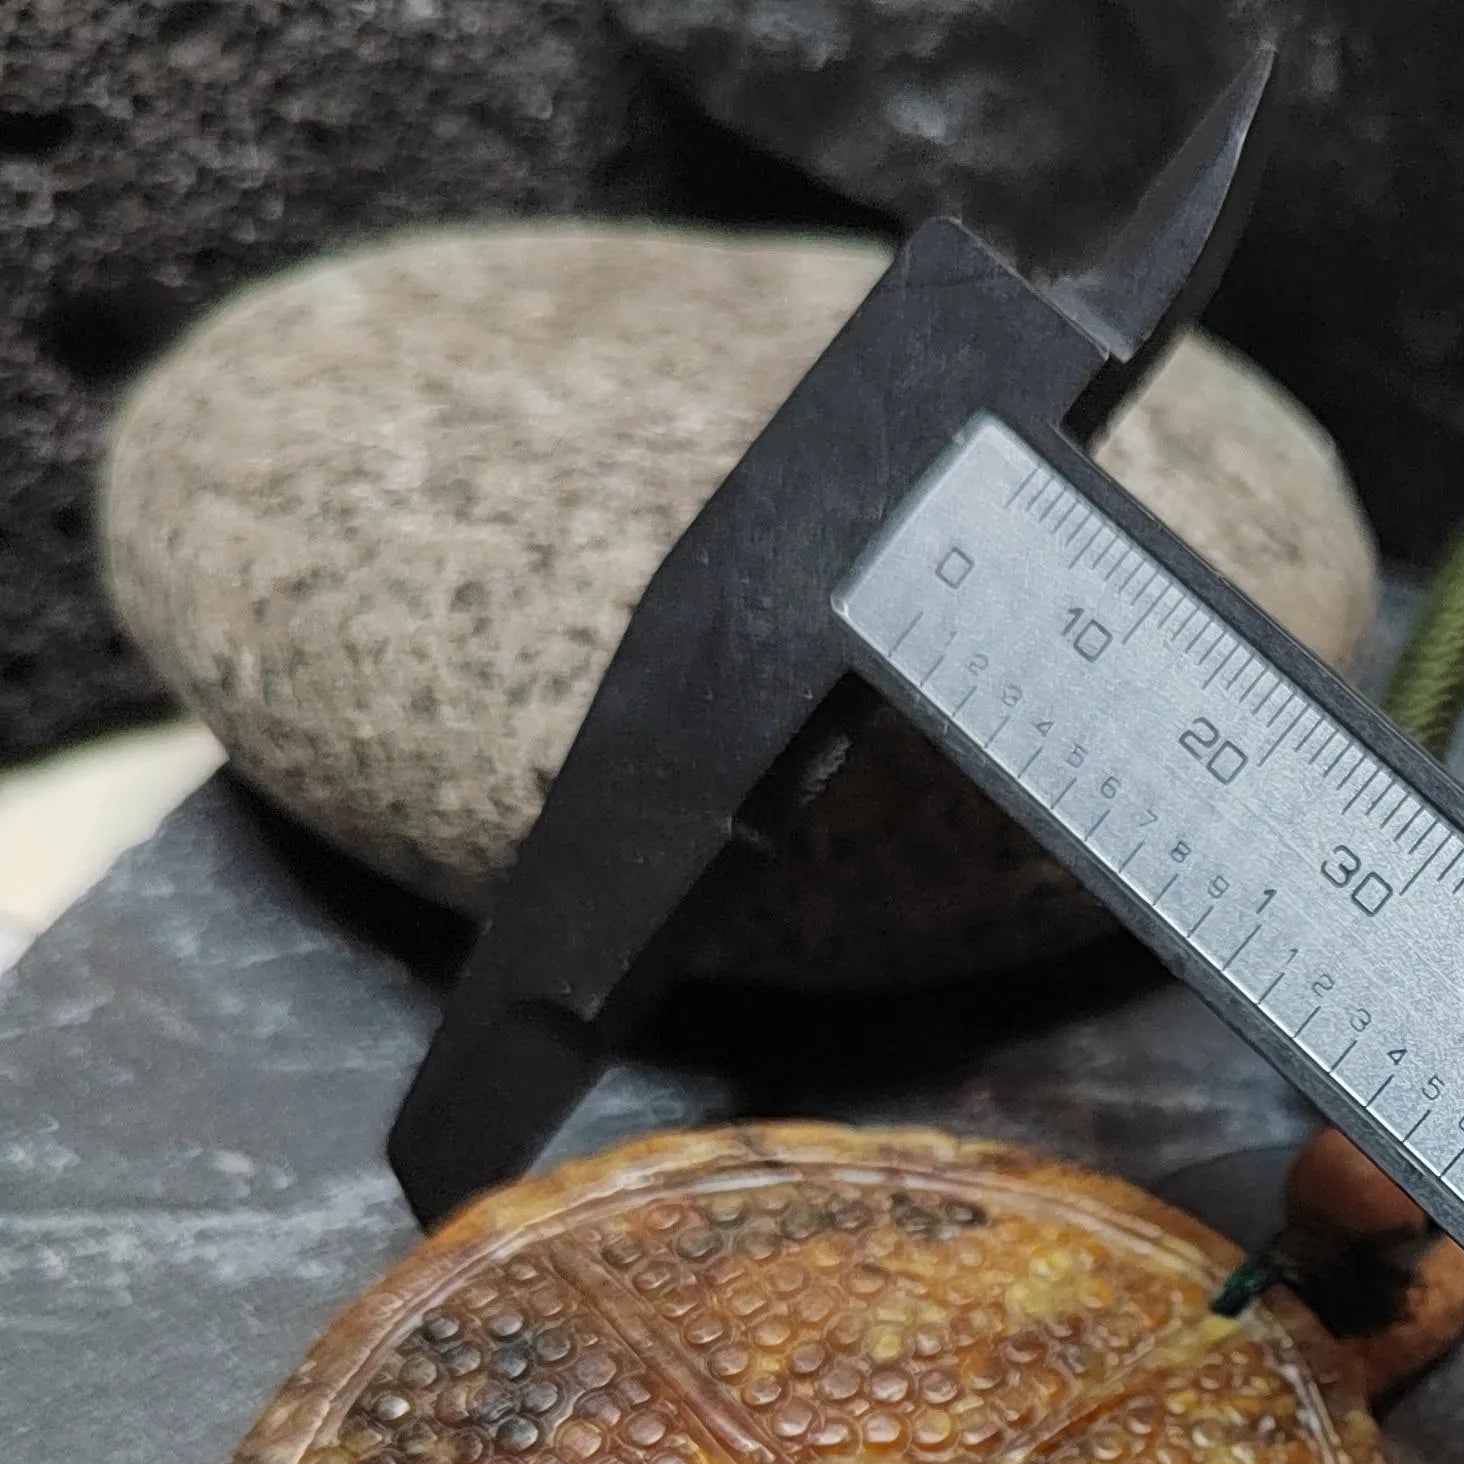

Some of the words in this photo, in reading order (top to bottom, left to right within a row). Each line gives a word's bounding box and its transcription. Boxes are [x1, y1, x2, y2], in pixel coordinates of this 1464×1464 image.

[935, 546, 974, 590] 0
[1060, 606, 1113, 663] 10
[1179, 717, 1248, 785] 20
[1320, 844, 1393, 915] 30
[968, 653, 989, 676] 2
[1000, 684, 1023, 708] 3
[1035, 718, 1054, 738] 4
[1066, 746, 1088, 768] 5
[1100, 776, 1121, 799] 6
[1138, 808, 1158, 828] 7
[1170, 840, 1191, 863] 8
[1207, 875, 1230, 899] 9
[1256, 889, 1277, 914] 1
[1313, 973, 1336, 996] 2
[1349, 1008, 1372, 1032] 3
[1389, 1047, 1408, 1066] 4
[1422, 1076, 1445, 1100] 5
